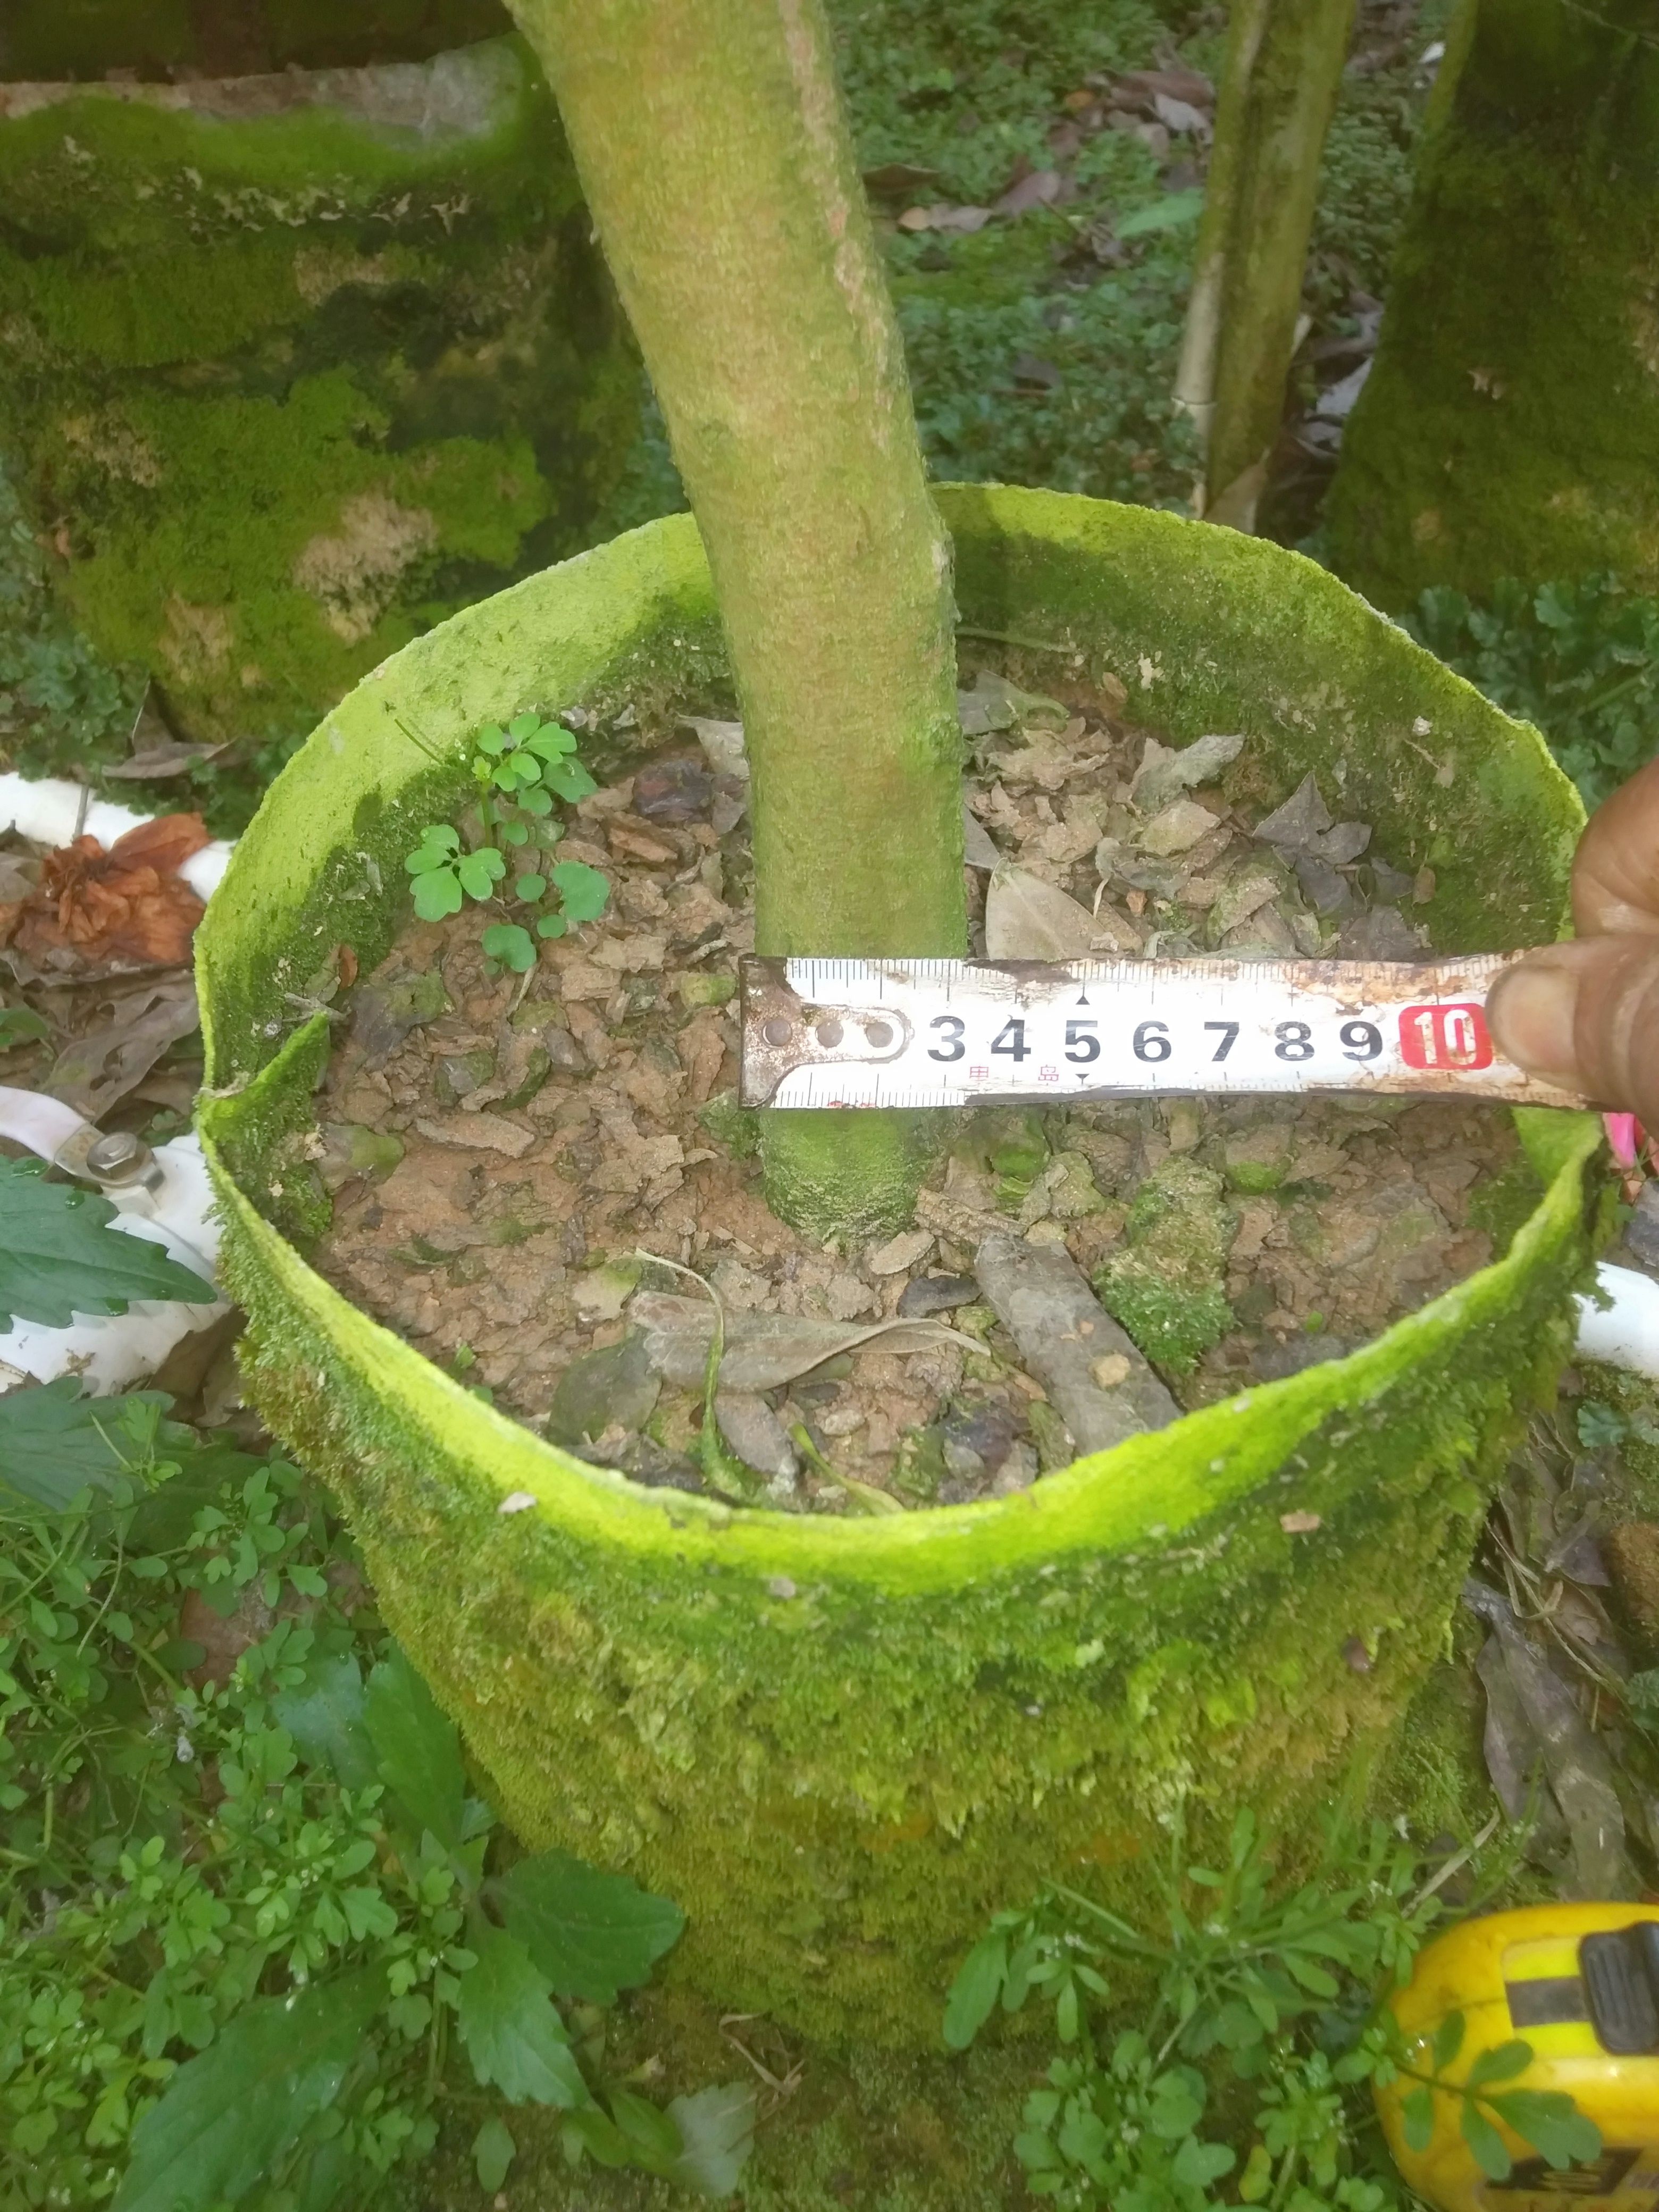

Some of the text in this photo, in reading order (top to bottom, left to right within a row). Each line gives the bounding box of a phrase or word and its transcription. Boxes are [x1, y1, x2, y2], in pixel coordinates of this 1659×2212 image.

[927, 1009, 1477, 1066] 3 4 5 6 7 8 9 10
